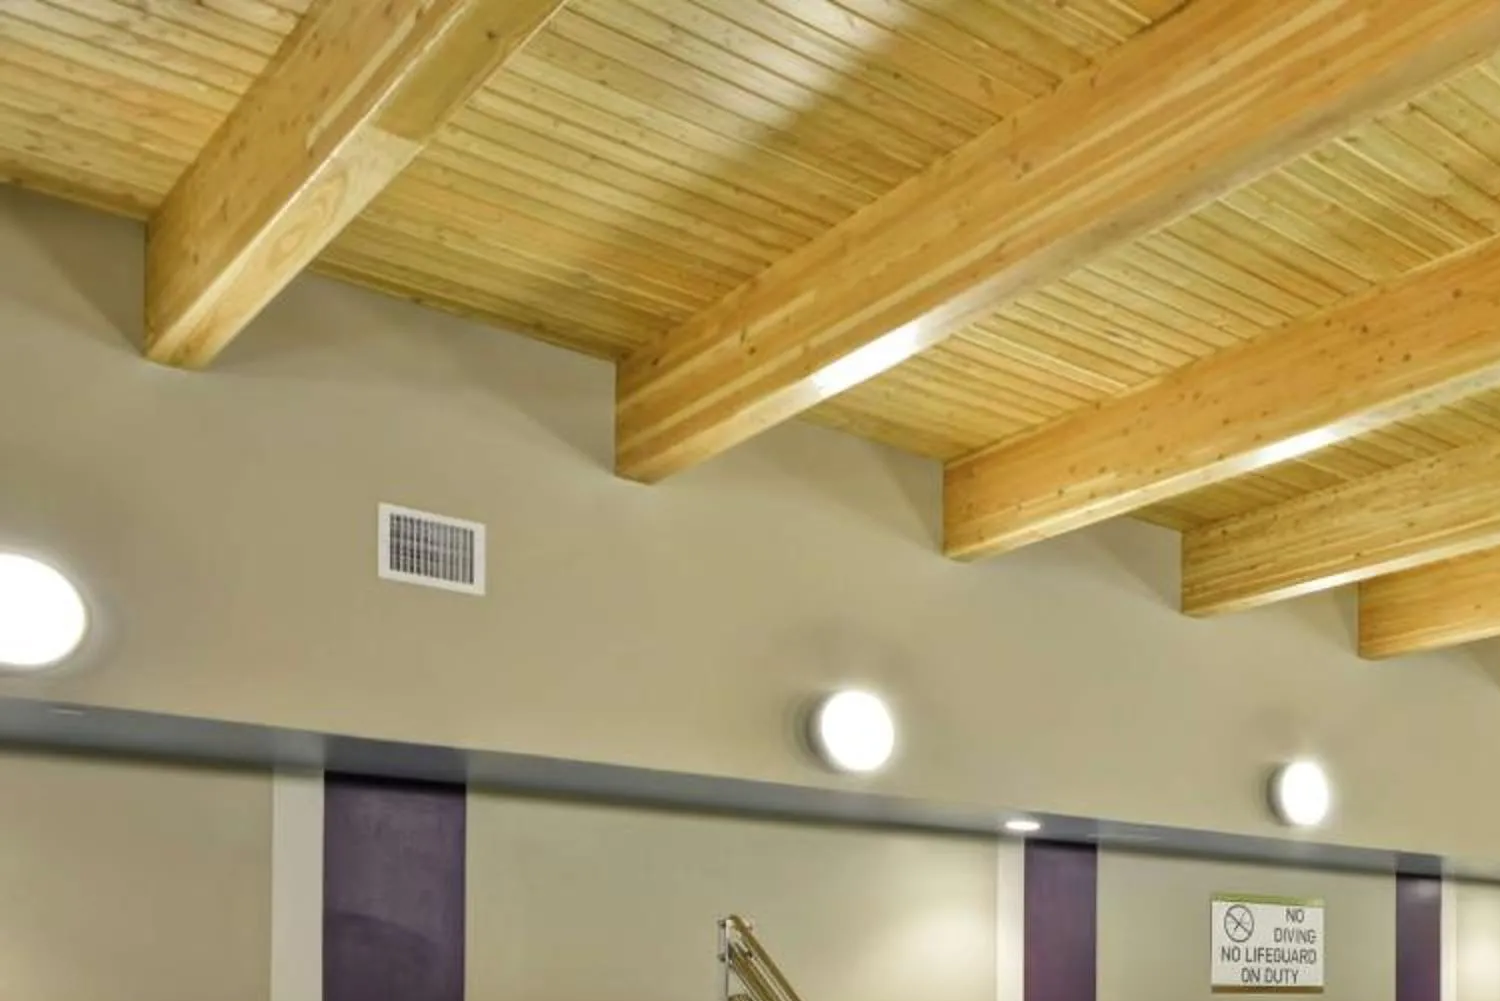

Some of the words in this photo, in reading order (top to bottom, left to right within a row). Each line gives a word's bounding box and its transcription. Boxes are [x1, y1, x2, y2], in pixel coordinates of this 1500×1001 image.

[1285, 908, 1305, 924] NO
[1273, 927, 1317, 944] DIVING
[1220, 945, 1241, 963] NO
[1245, 946, 1317, 965] LIFEGUARD
[1241, 967, 1261, 983] ON
[1265, 967, 1300, 984] DUTY
